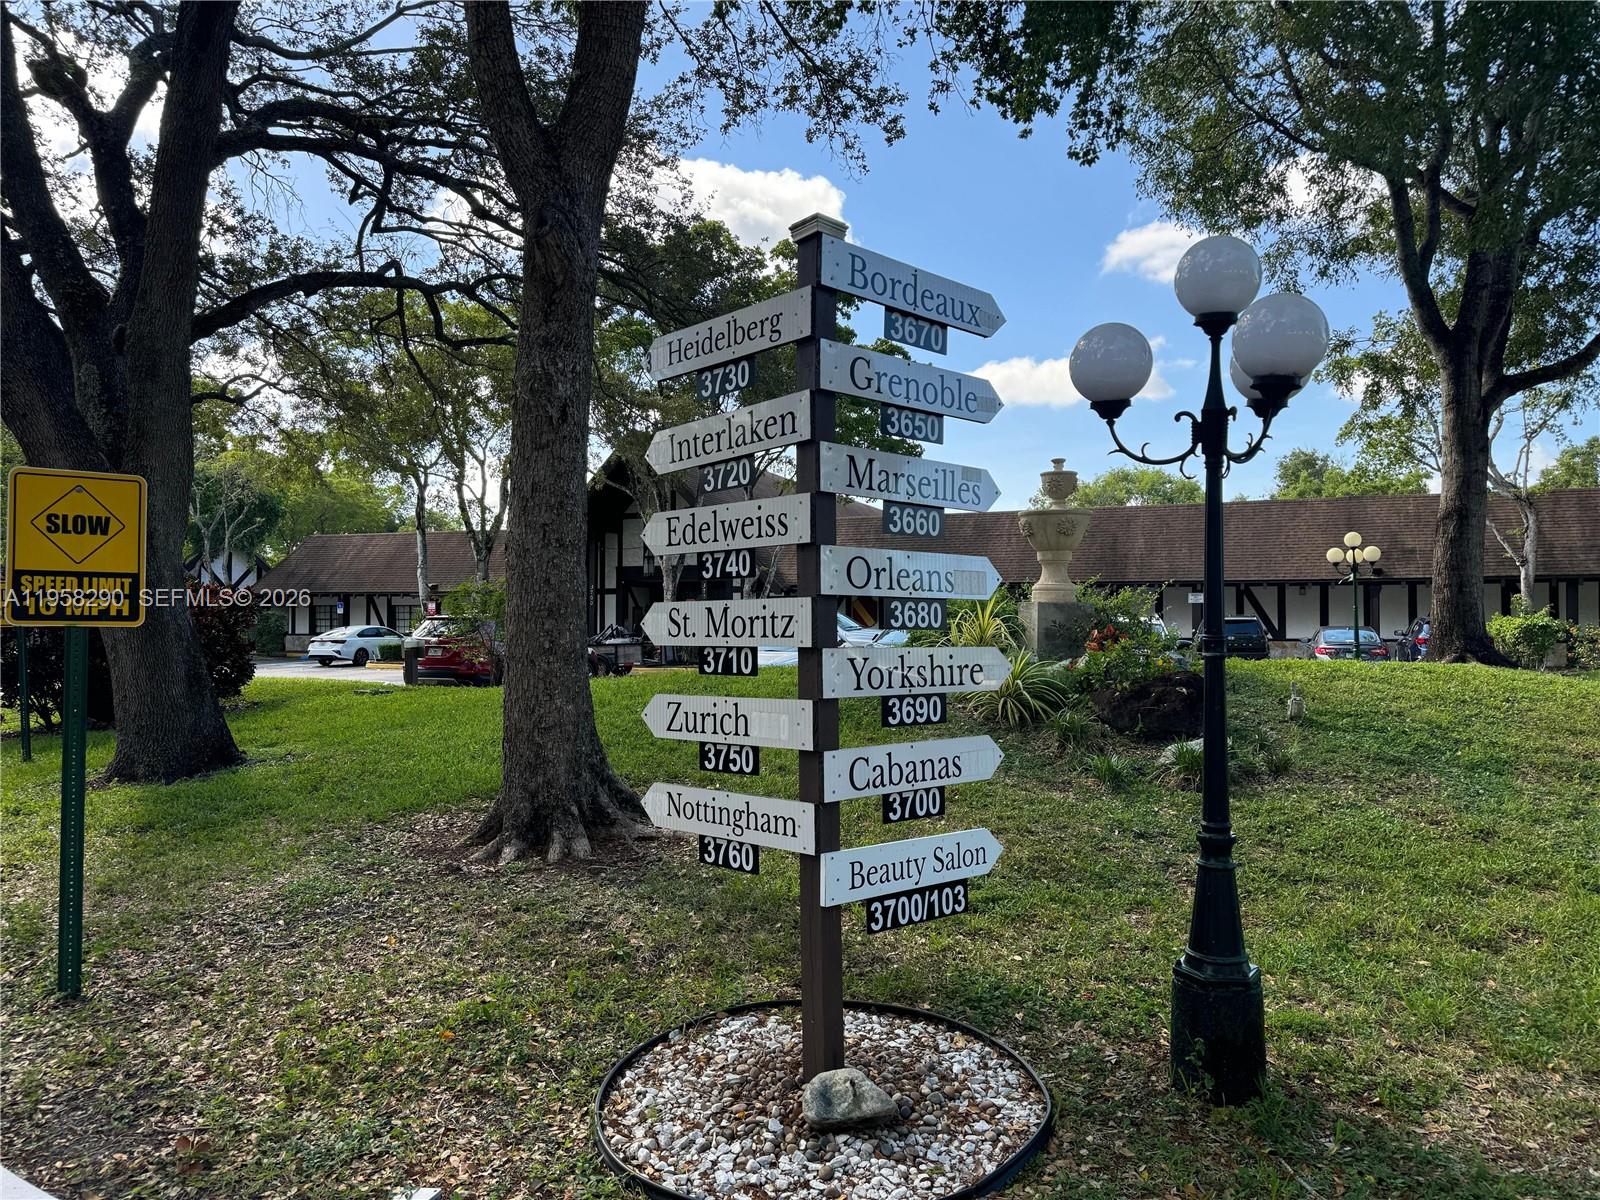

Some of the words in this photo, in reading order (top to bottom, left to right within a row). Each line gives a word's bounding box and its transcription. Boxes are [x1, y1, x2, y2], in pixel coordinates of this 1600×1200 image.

[847, 252, 983, 328] Bordeaux
[667, 311, 784, 366] Heidelberg
[890, 312, 943, 351] 3670
[700, 360, 749, 398] 3730
[850, 357, 978, 413] Grenoble
[669, 410, 798, 464] Interlaken
[886, 407, 940, 441] 3650
[703, 458, 750, 492] 3720
[846, 455, 982, 506] Marseilles
[46, 513, 111, 536] SLOW
[666, 511, 789, 547] Edelweiss
[889, 506, 940, 536] 3660
[702, 551, 750, 579] 3740
[846, 556, 954, 594] Orleans
[20, 575, 78, 592] SPEED
[83, 577, 132, 594] LIMIT
[23, 597, 57, 615] 10
[66, 598, 130, 616] MPH
[668, 608, 696, 638] St.
[706, 605, 795, 639] Moritz
[890, 601, 941, 628] 3680
[704, 648, 751, 675] 3710
[847, 655, 985, 691] Yorkshire
[666, 701, 750, 737] Zurich
[888, 697, 942, 724] 3690
[704, 743, 754, 773] 3750
[850, 752, 962, 792] Cabanas
[667, 791, 798, 838] Nottingham
[889, 788, 940, 821] 3700
[704, 837, 754, 871] 3760
[849, 857, 927, 890] Beauty
[933, 844, 988, 873] Salon
[870, 885, 966, 932] 3700/103
